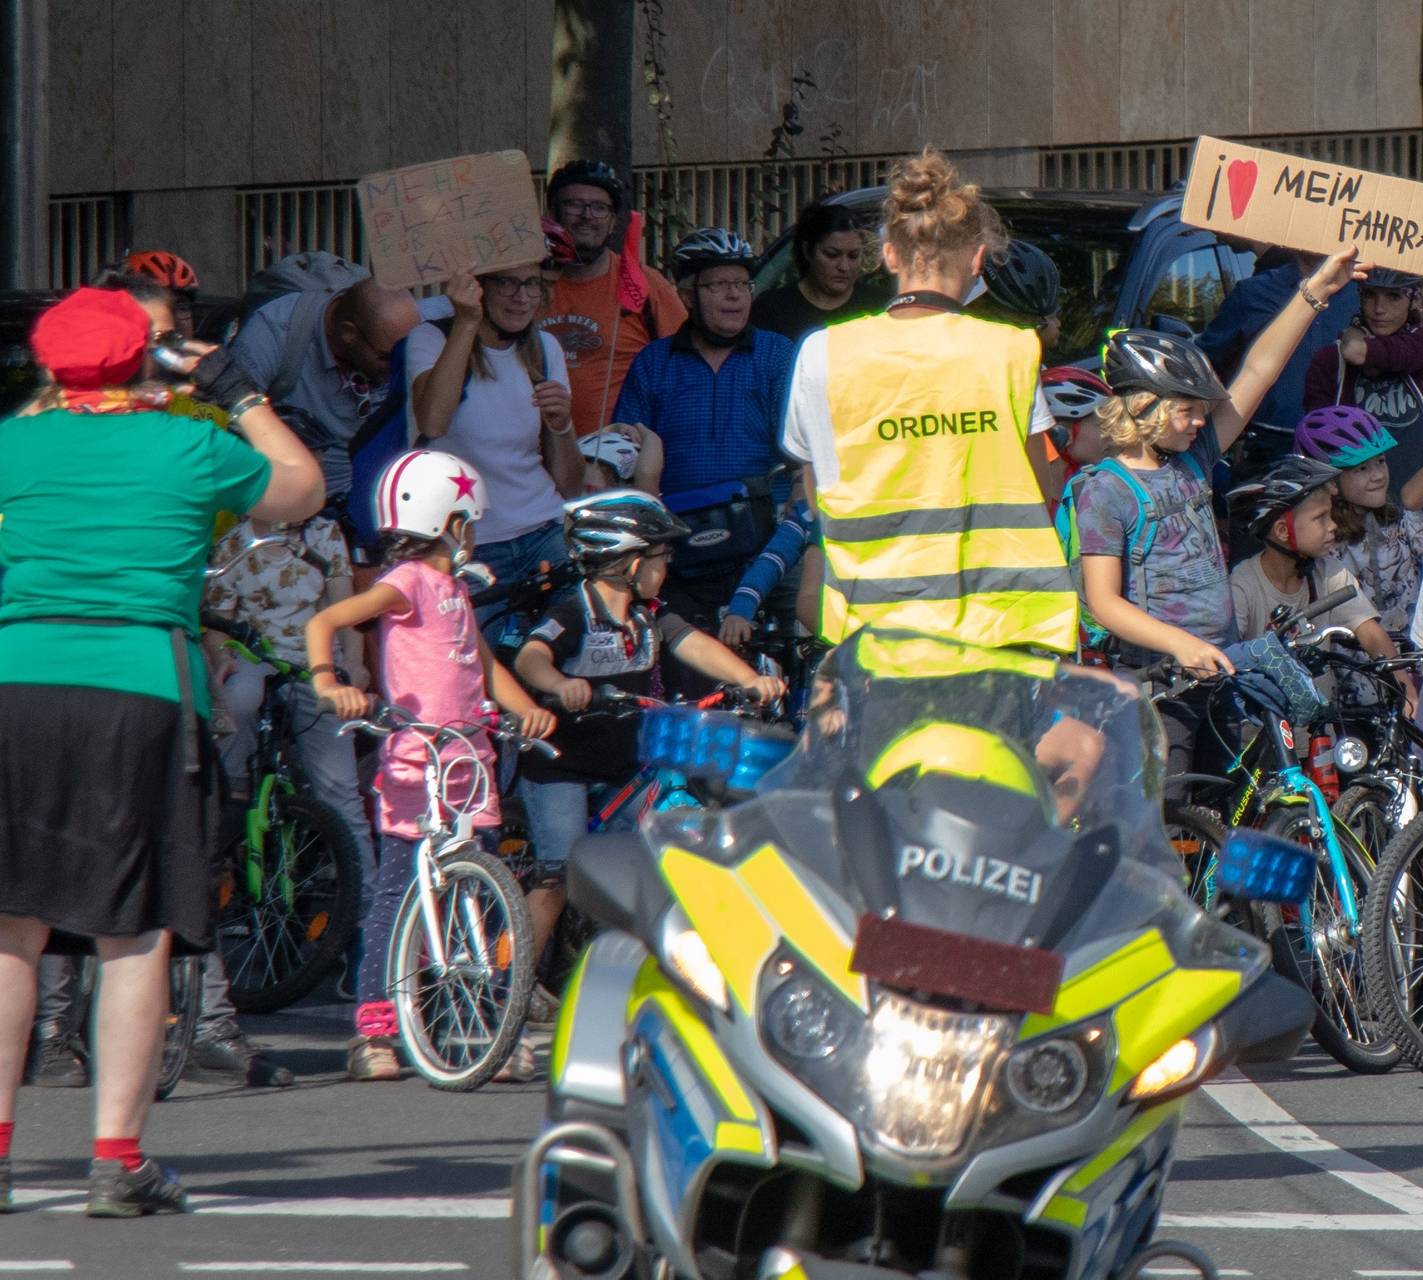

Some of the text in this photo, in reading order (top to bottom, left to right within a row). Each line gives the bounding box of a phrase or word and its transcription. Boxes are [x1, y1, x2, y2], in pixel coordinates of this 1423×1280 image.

[366, 160, 475, 209] MEHR
[373, 191, 493, 235] PLATZ
[412, 213, 540, 280] KINDER
[877, 410, 999, 441] ORDNER
[897, 845, 1043, 904] POLIZEI
